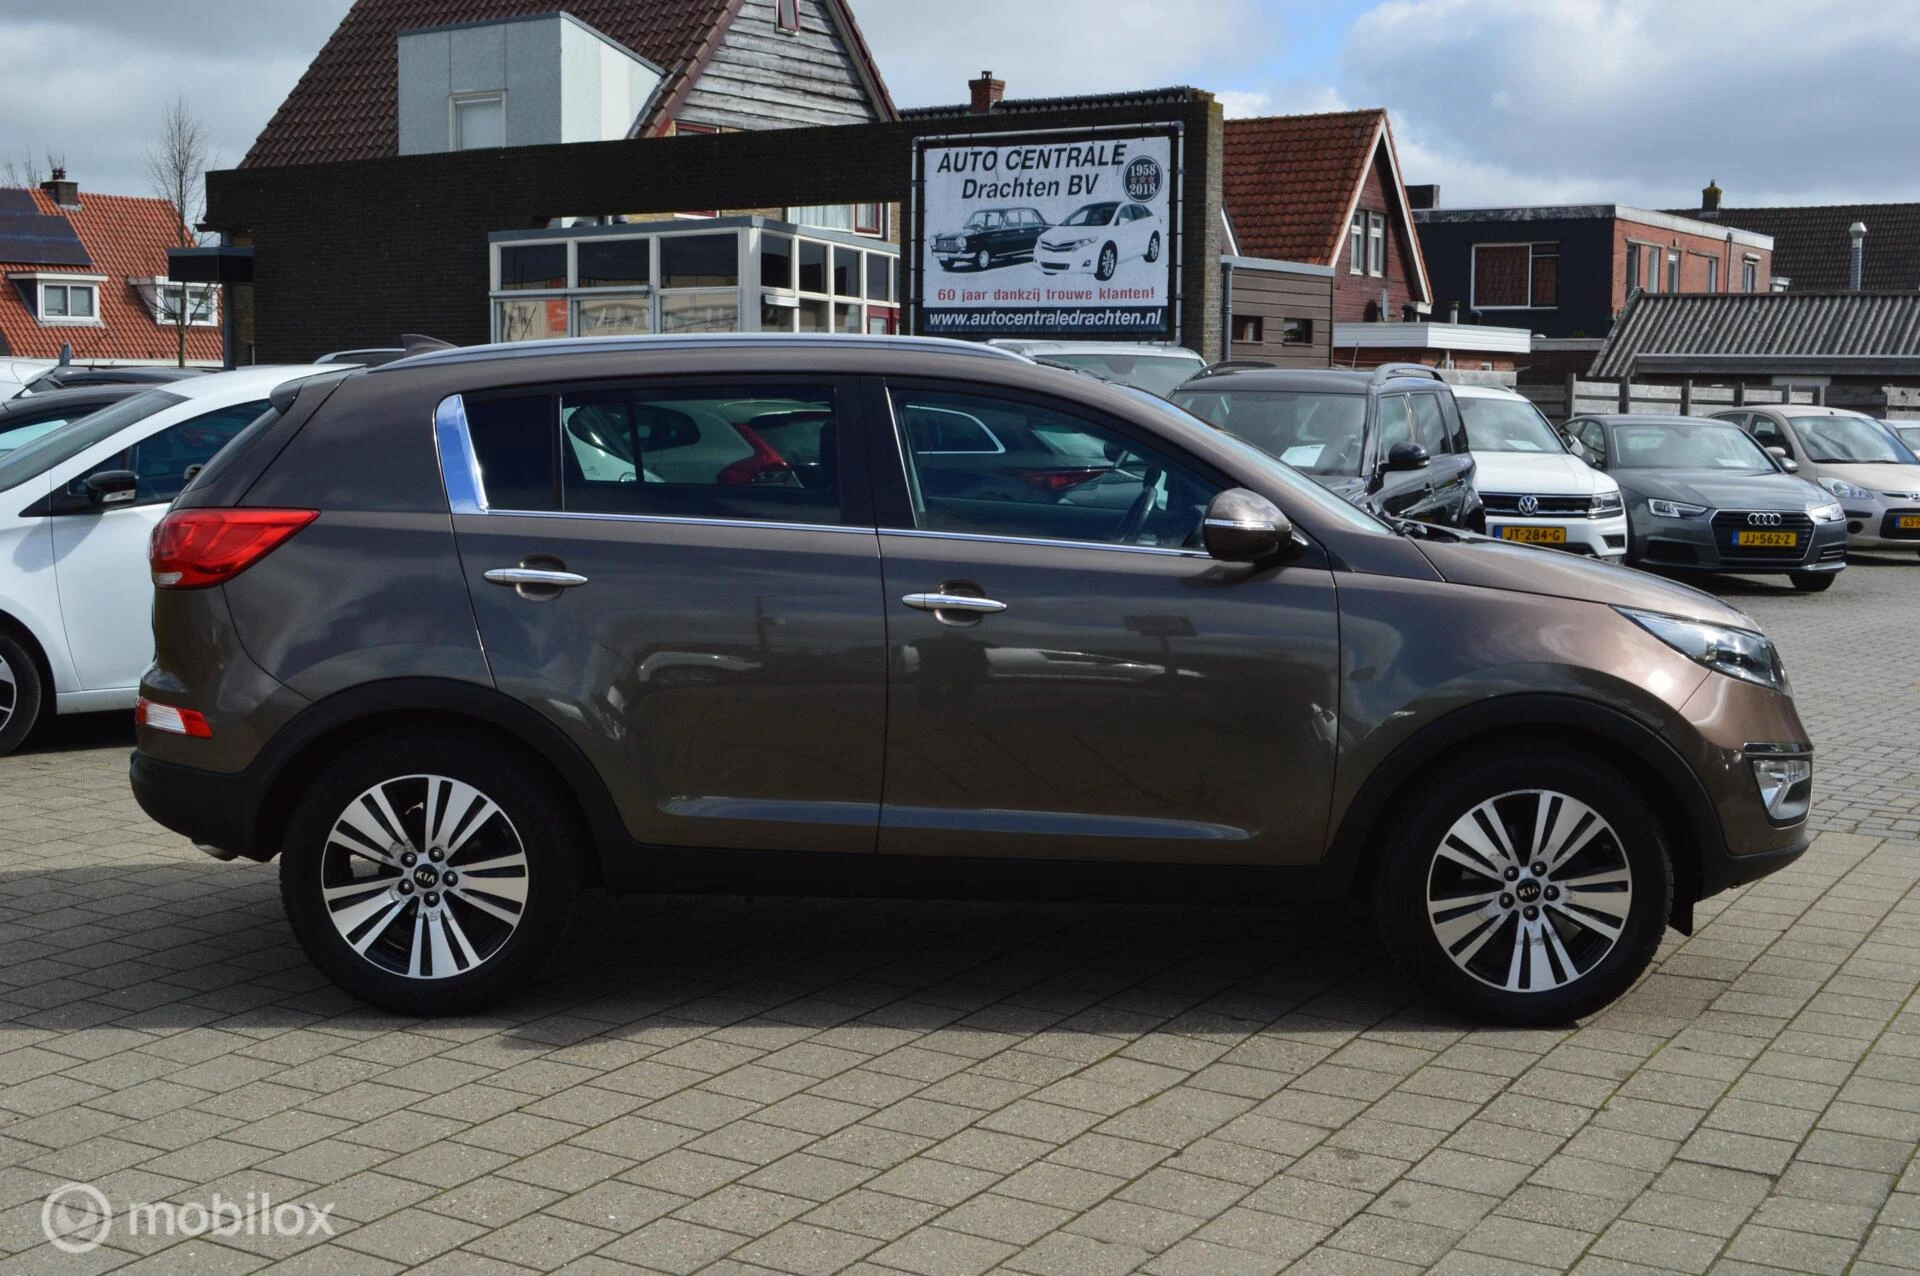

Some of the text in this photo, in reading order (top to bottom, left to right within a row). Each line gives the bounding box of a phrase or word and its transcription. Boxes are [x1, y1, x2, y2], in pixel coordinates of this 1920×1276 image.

[937, 144, 1127, 173] AUTO CENTRALE
[1130, 163, 1156, 176] 1958
[962, 174, 1099, 199] Drachten BV
[1129, 182, 1156, 196] 2018
[937, 286, 1155, 303] 60 jaar dankzij trouwe klanten!
[929, 308, 1162, 327] www.autocentraledrachten.nl
[1508, 527, 1560, 541] JT-284-G
[1743, 534, 1792, 545] JJ-562-Z
[415, 871, 436, 884] KIA
